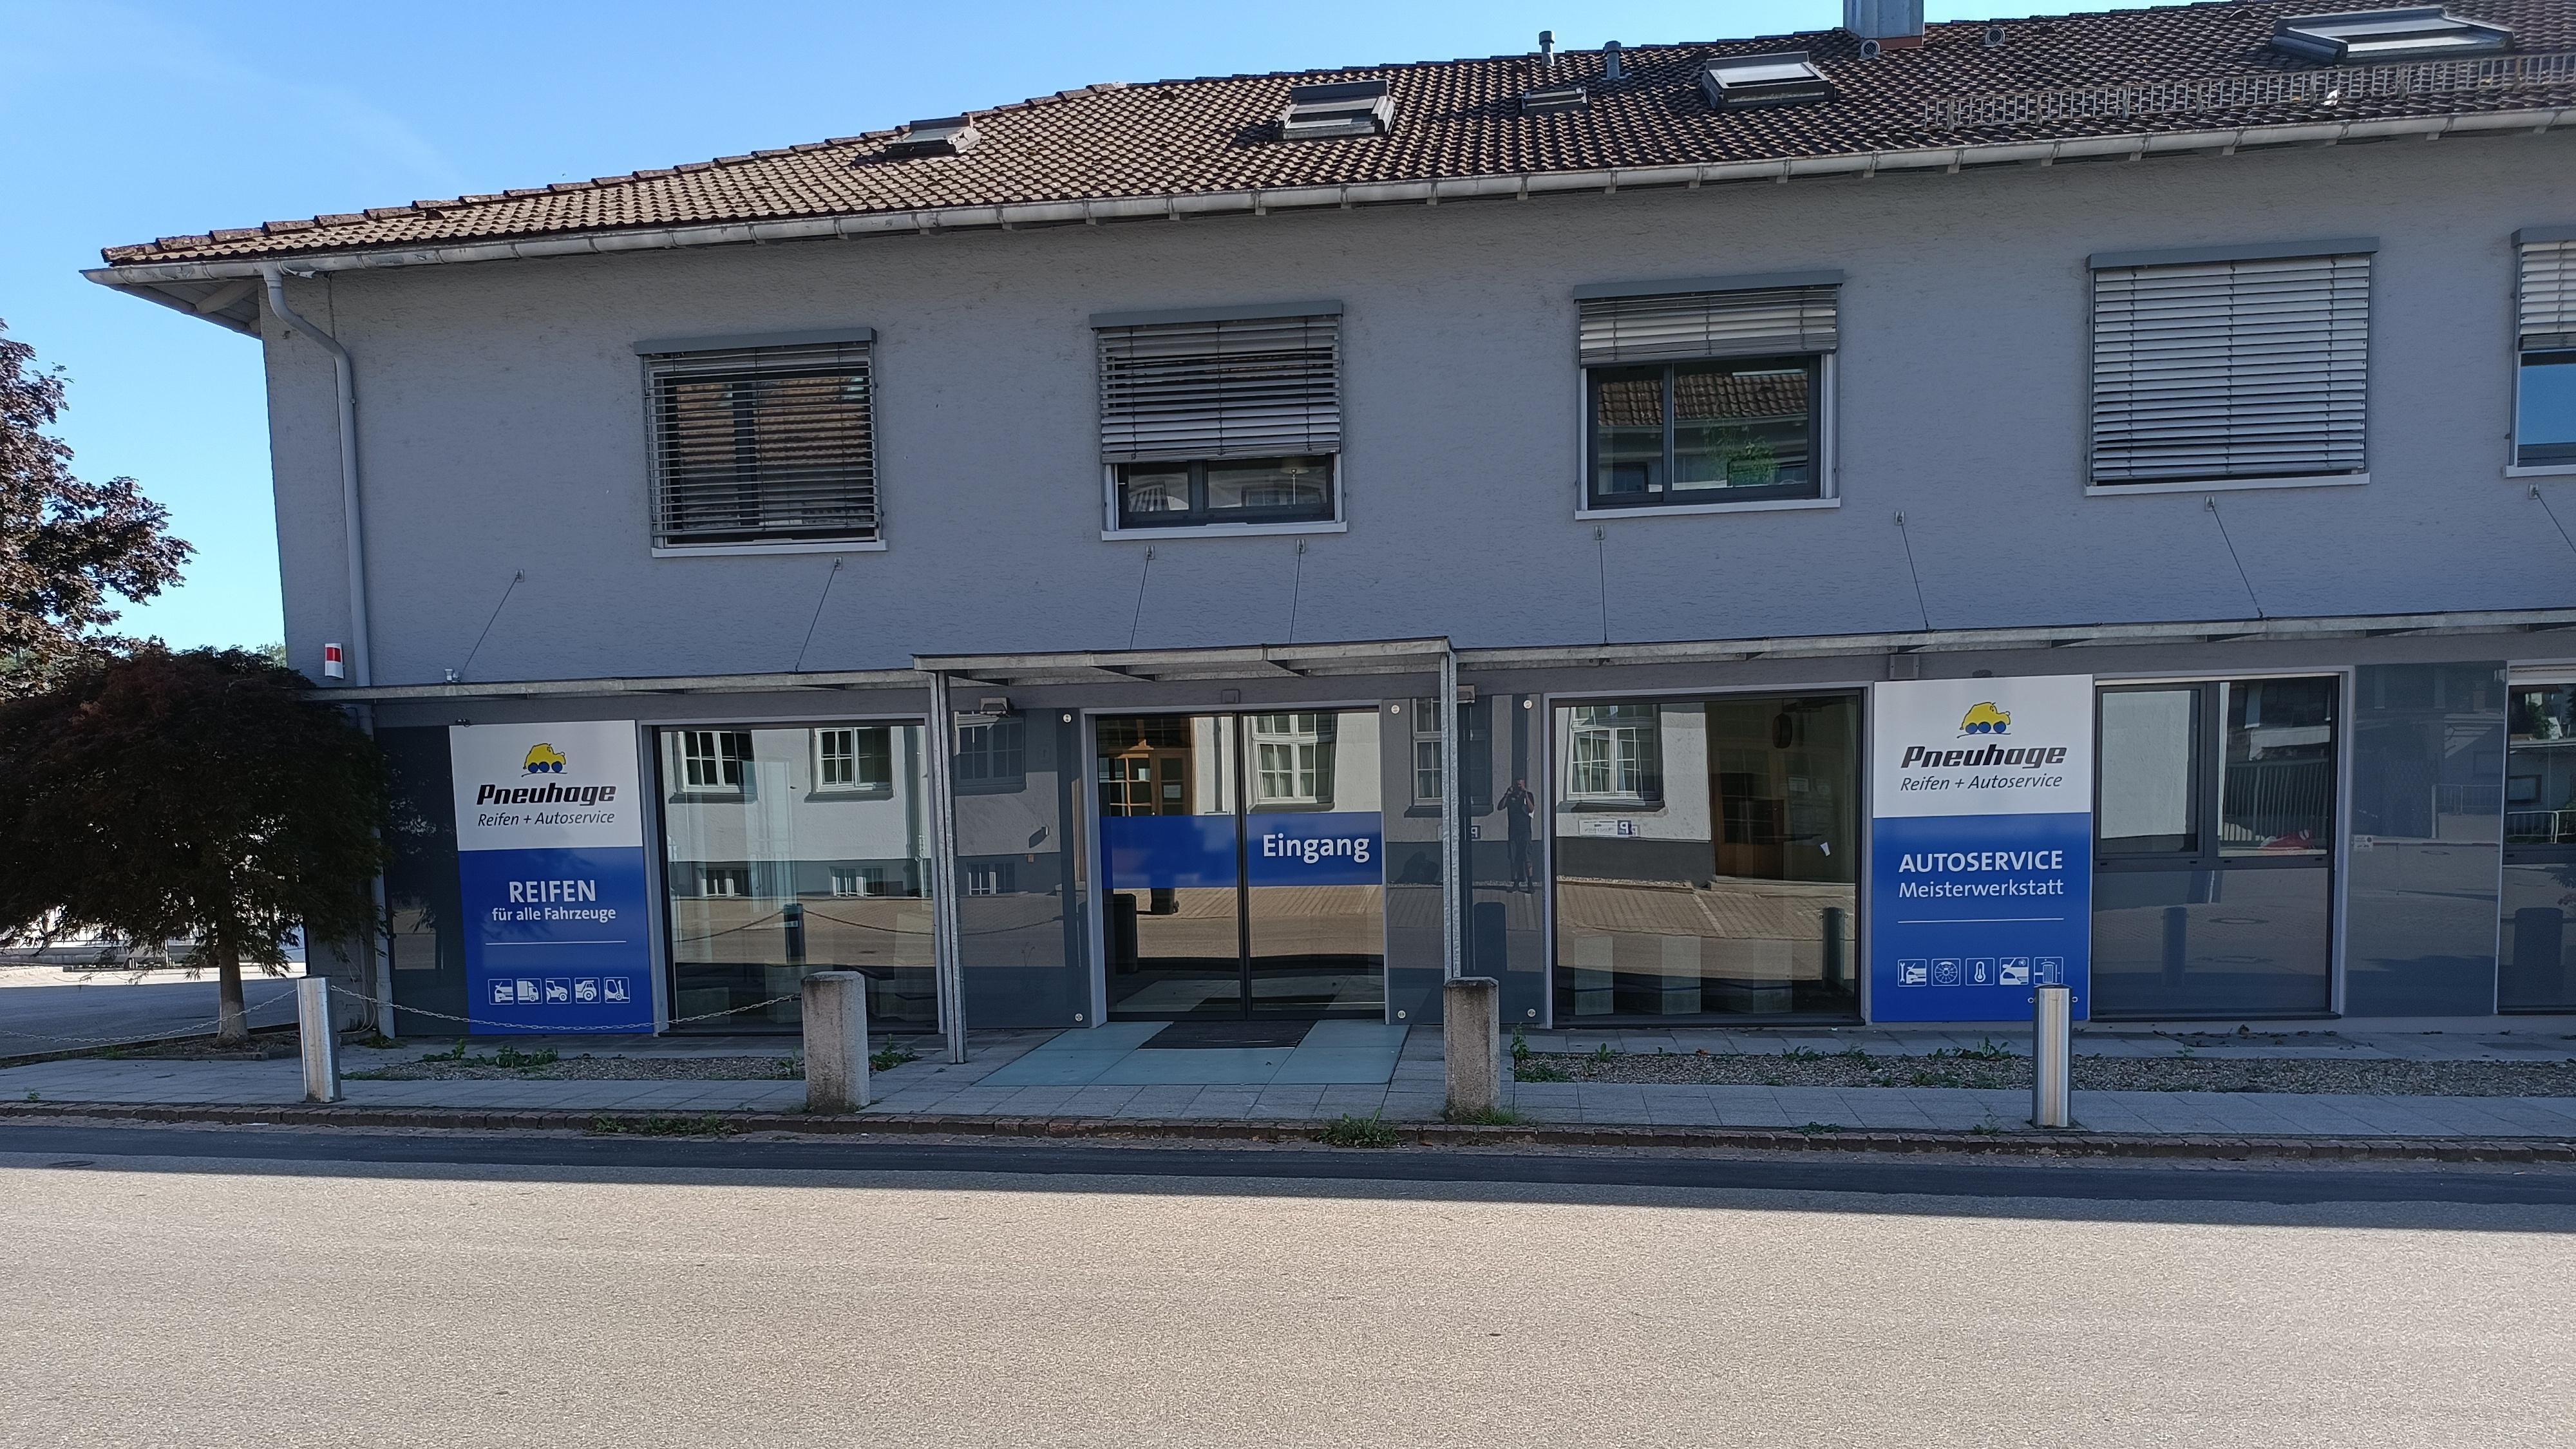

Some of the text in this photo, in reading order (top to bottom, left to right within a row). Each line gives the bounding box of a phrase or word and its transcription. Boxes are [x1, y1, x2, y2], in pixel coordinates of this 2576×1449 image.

[1900, 744, 2067, 769] Pneuhage
[1900, 773, 2063, 791] Reifen + Autoservice
[477, 782, 616, 806] Pneuhage
[478, 810, 615, 826] Reifen + Autoservice
[1263, 833, 1370, 864] Eingang
[1899, 850, 2063, 873] AUTOSERVICE
[509, 880, 596, 903] REIFEN
[1899, 879, 2064, 898] Meisterwerkstatt
[492, 906, 616, 923] für alle Fahrzeuge
